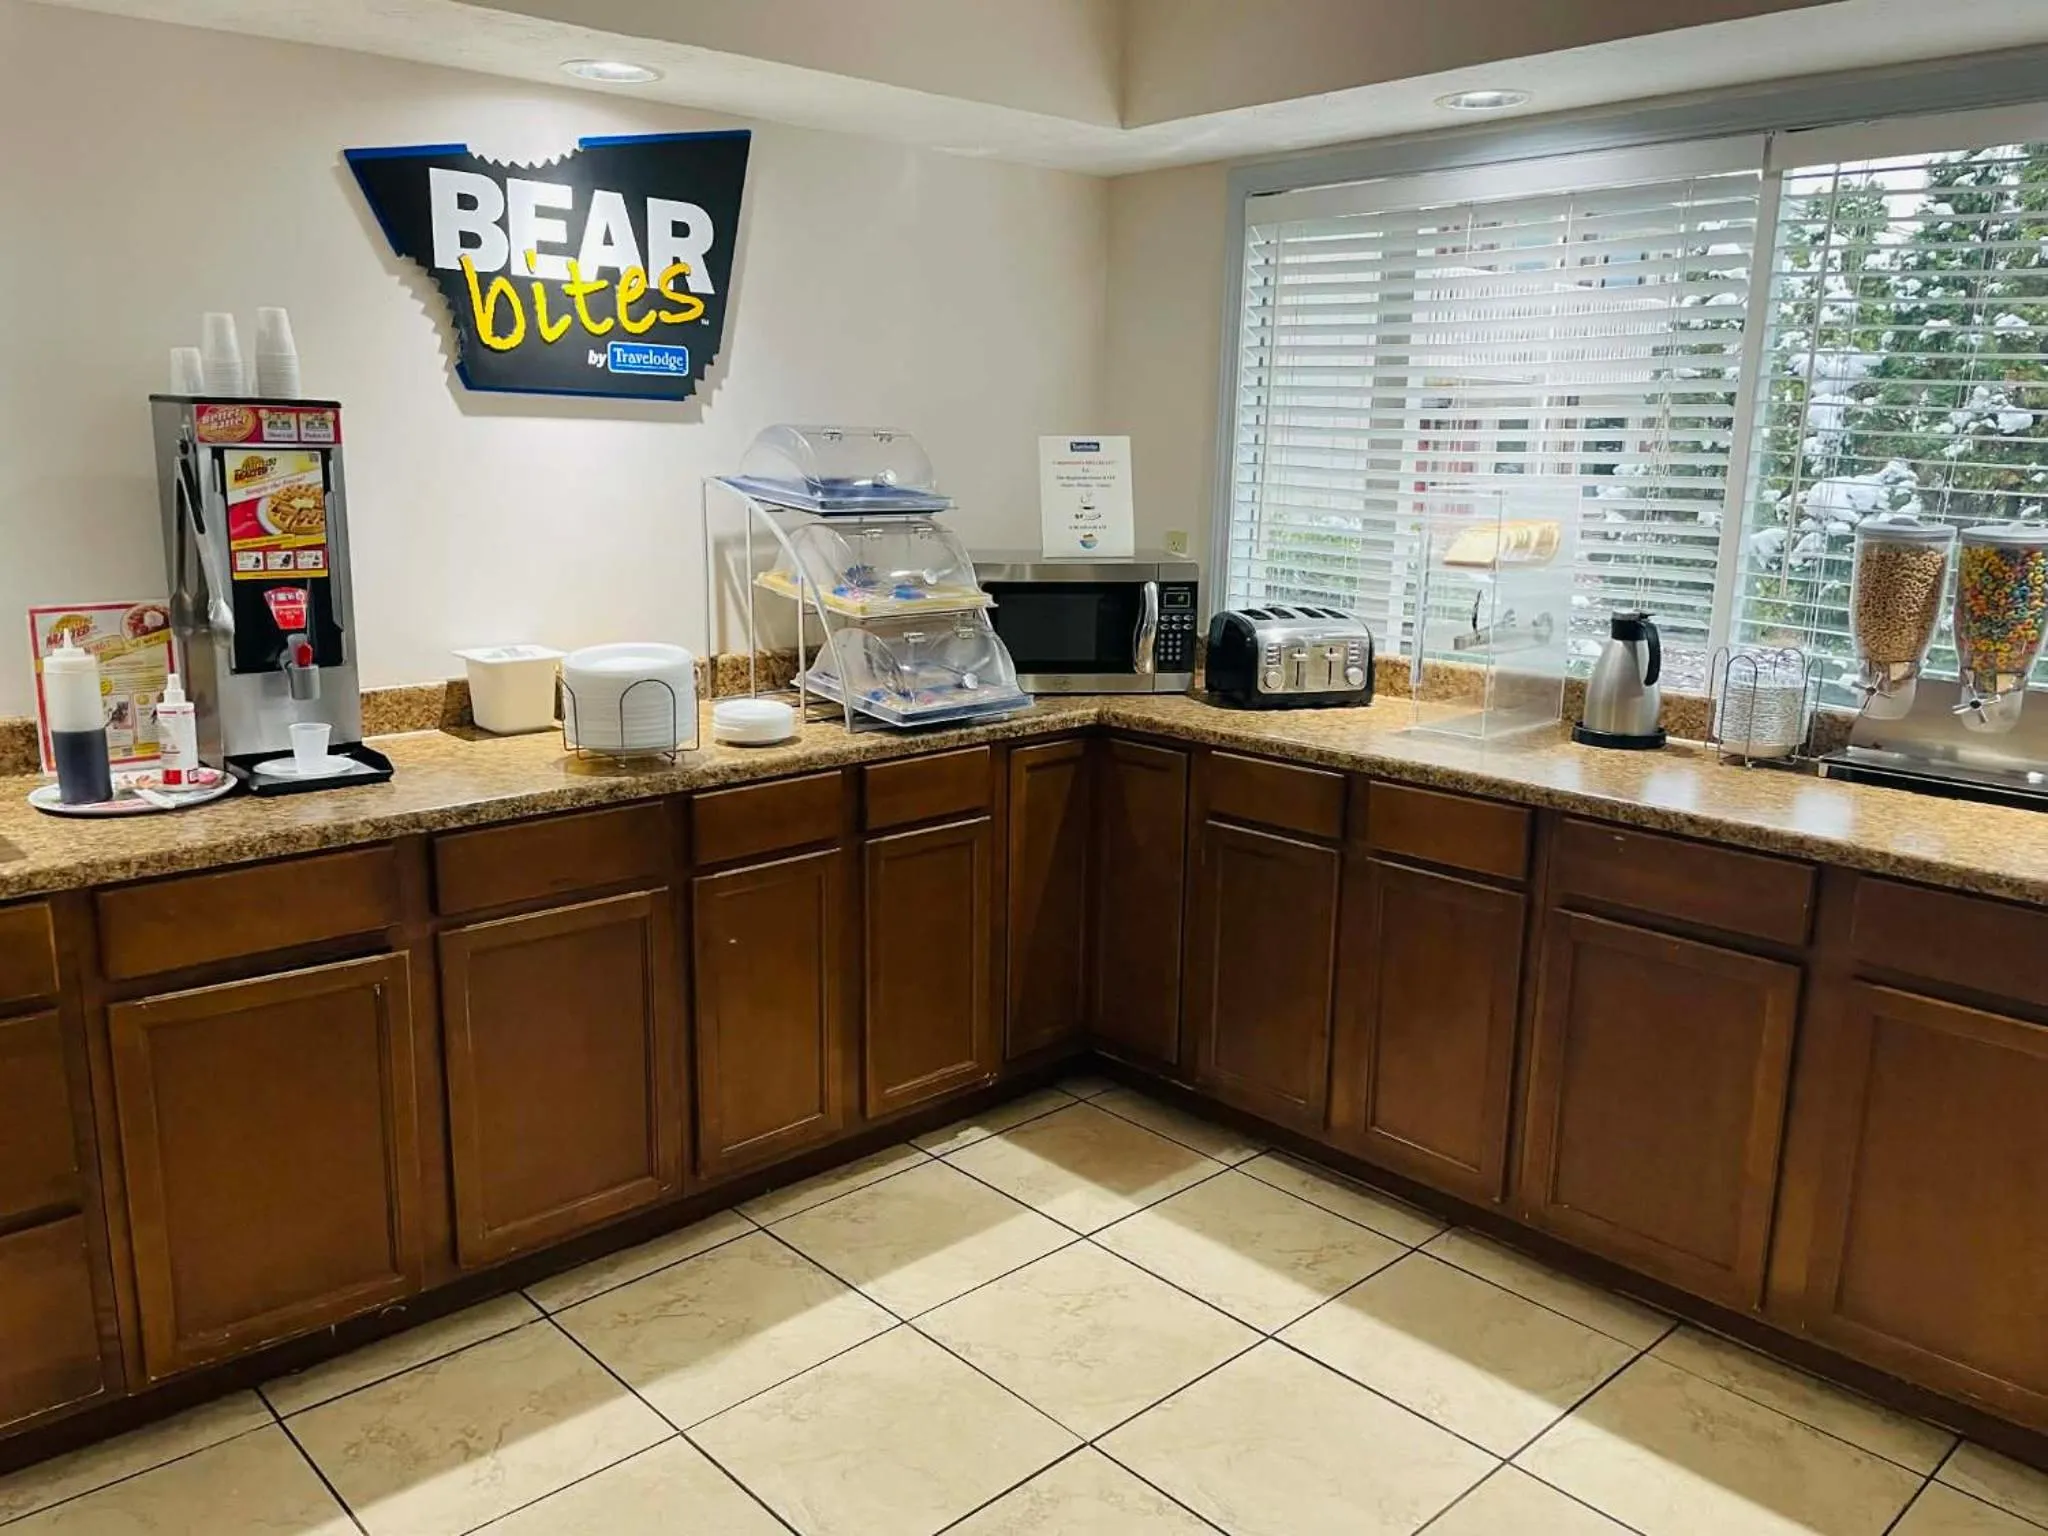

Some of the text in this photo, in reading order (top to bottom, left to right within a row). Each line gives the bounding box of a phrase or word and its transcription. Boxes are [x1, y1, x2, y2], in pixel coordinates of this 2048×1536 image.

[429, 167, 715, 295] BEAR
[459, 248, 705, 351] bites
[587, 347, 684, 371] by Travelodge
